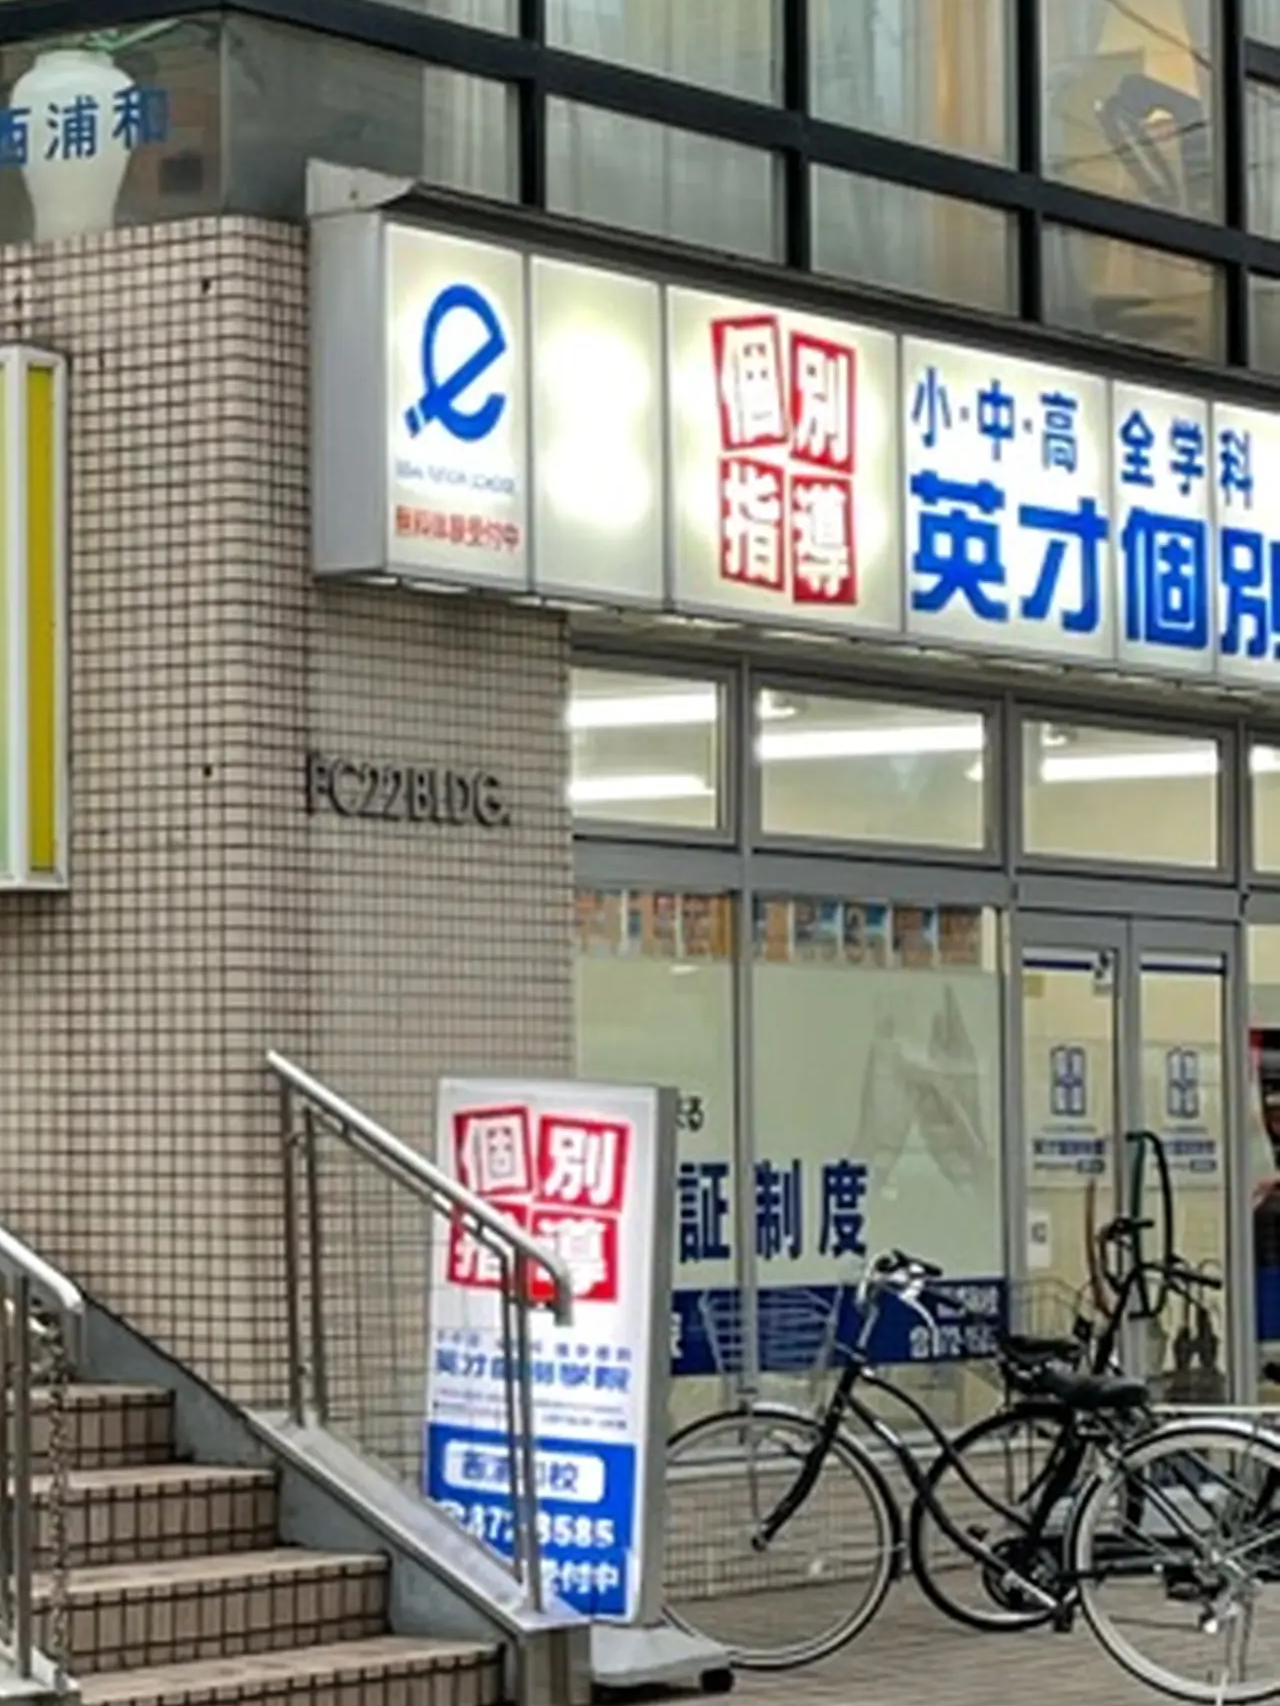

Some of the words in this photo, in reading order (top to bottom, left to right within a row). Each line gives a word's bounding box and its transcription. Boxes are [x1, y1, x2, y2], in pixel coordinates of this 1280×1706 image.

[715, 320, 852, 470] 個別
[1119, 409, 1254, 509] 全学科
[721, 457, 854, 601] 指導
[456, 1117, 622, 1202] 個別
